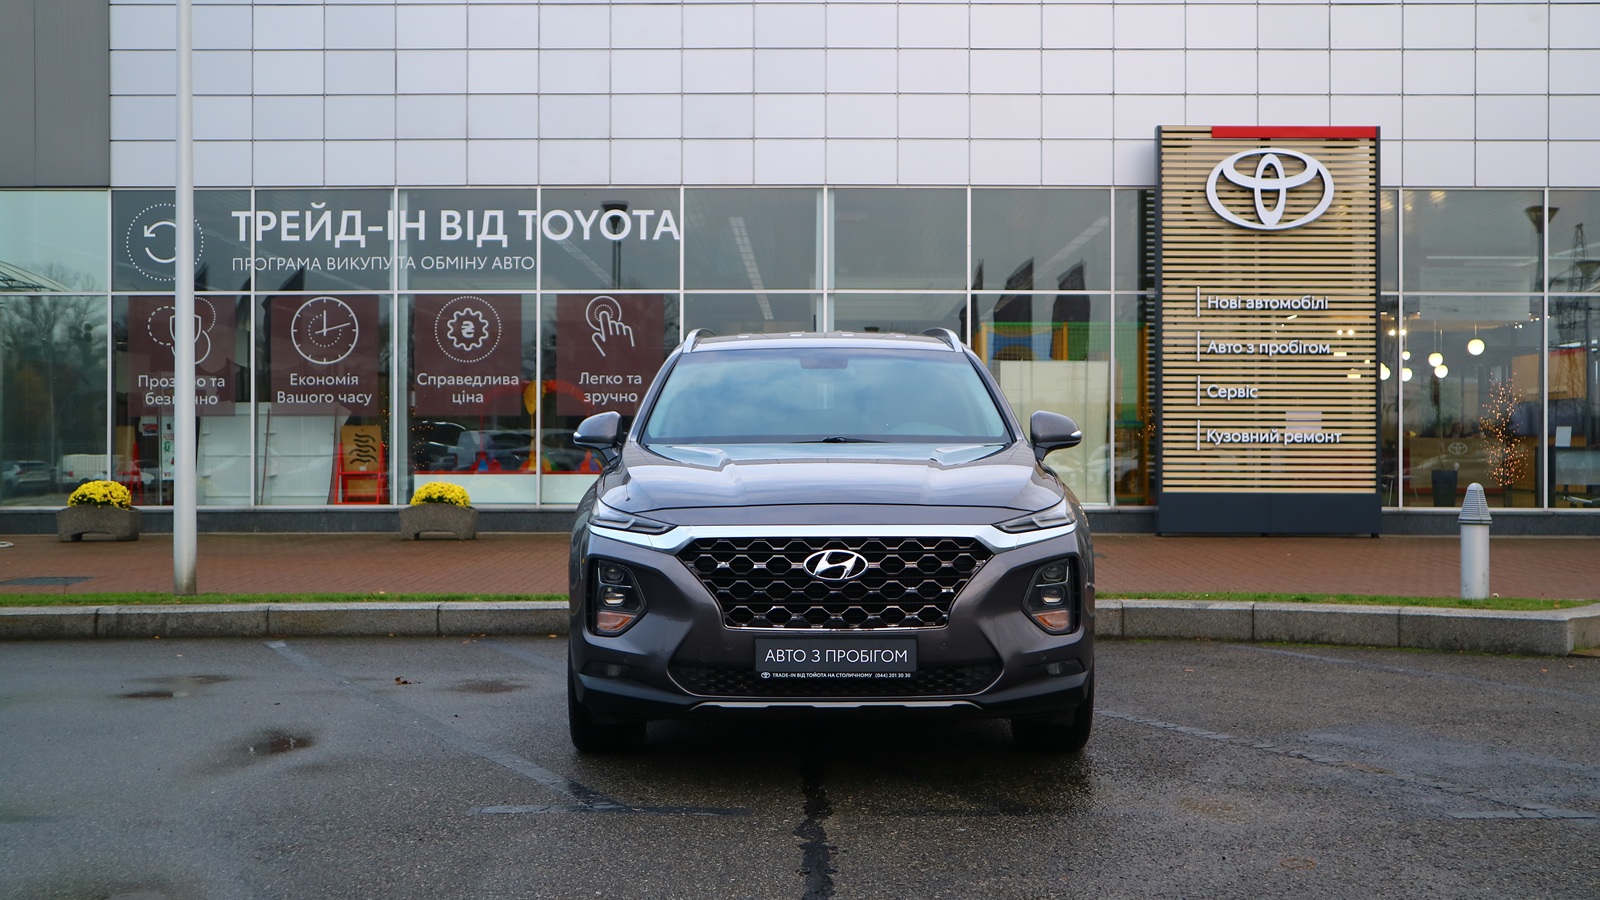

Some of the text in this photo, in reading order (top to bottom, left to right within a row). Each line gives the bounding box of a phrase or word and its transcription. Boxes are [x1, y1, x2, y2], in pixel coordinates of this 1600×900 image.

[231, 202, 680, 248] ТРЕЙД-ІН ВІД TOYOTA
[232, 255, 535, 271] ПРОГРАМА ВИКУПУ ТА ОБМІНУ АВТО
[1207, 295, 1329, 310] Нові автомобілі
[1207, 340, 1330, 357] Авто з пробігом
[138, 375, 225, 390] Прозо та
[290, 373, 359, 386] Економія
[417, 373, 519, 388] Справедлива
[579, 372, 642, 385] Легко та
[277, 391, 372, 406] Вашого часу
[452, 390, 484, 404] ціна
[583, 392, 638, 406] зручно
[1207, 385, 1259, 401] Сервіс
[1206, 429, 1342, 446] Кузовний ремонт
[765, 649, 908, 663] АВТО З ПРОБІГОМ
